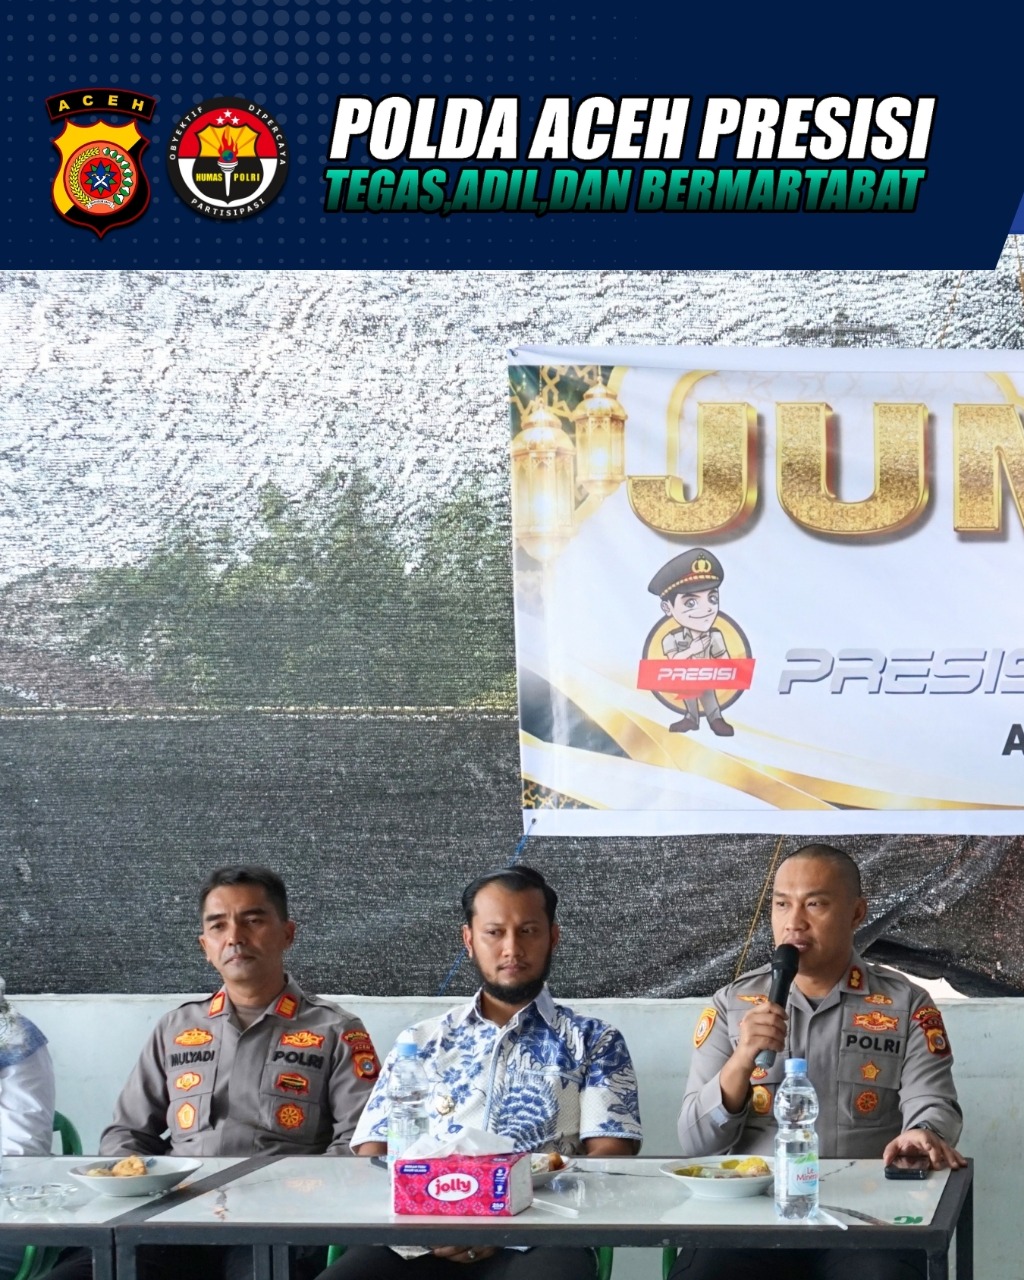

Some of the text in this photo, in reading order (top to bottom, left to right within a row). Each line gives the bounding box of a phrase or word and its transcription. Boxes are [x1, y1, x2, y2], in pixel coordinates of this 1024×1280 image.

[657, 667, 737, 681] PRESISI
[846, 1034, 901, 1054] POLRI
[171, 1050, 325, 1069] MULYADI POLRI
[435, 1179, 471, 1195] jolly
